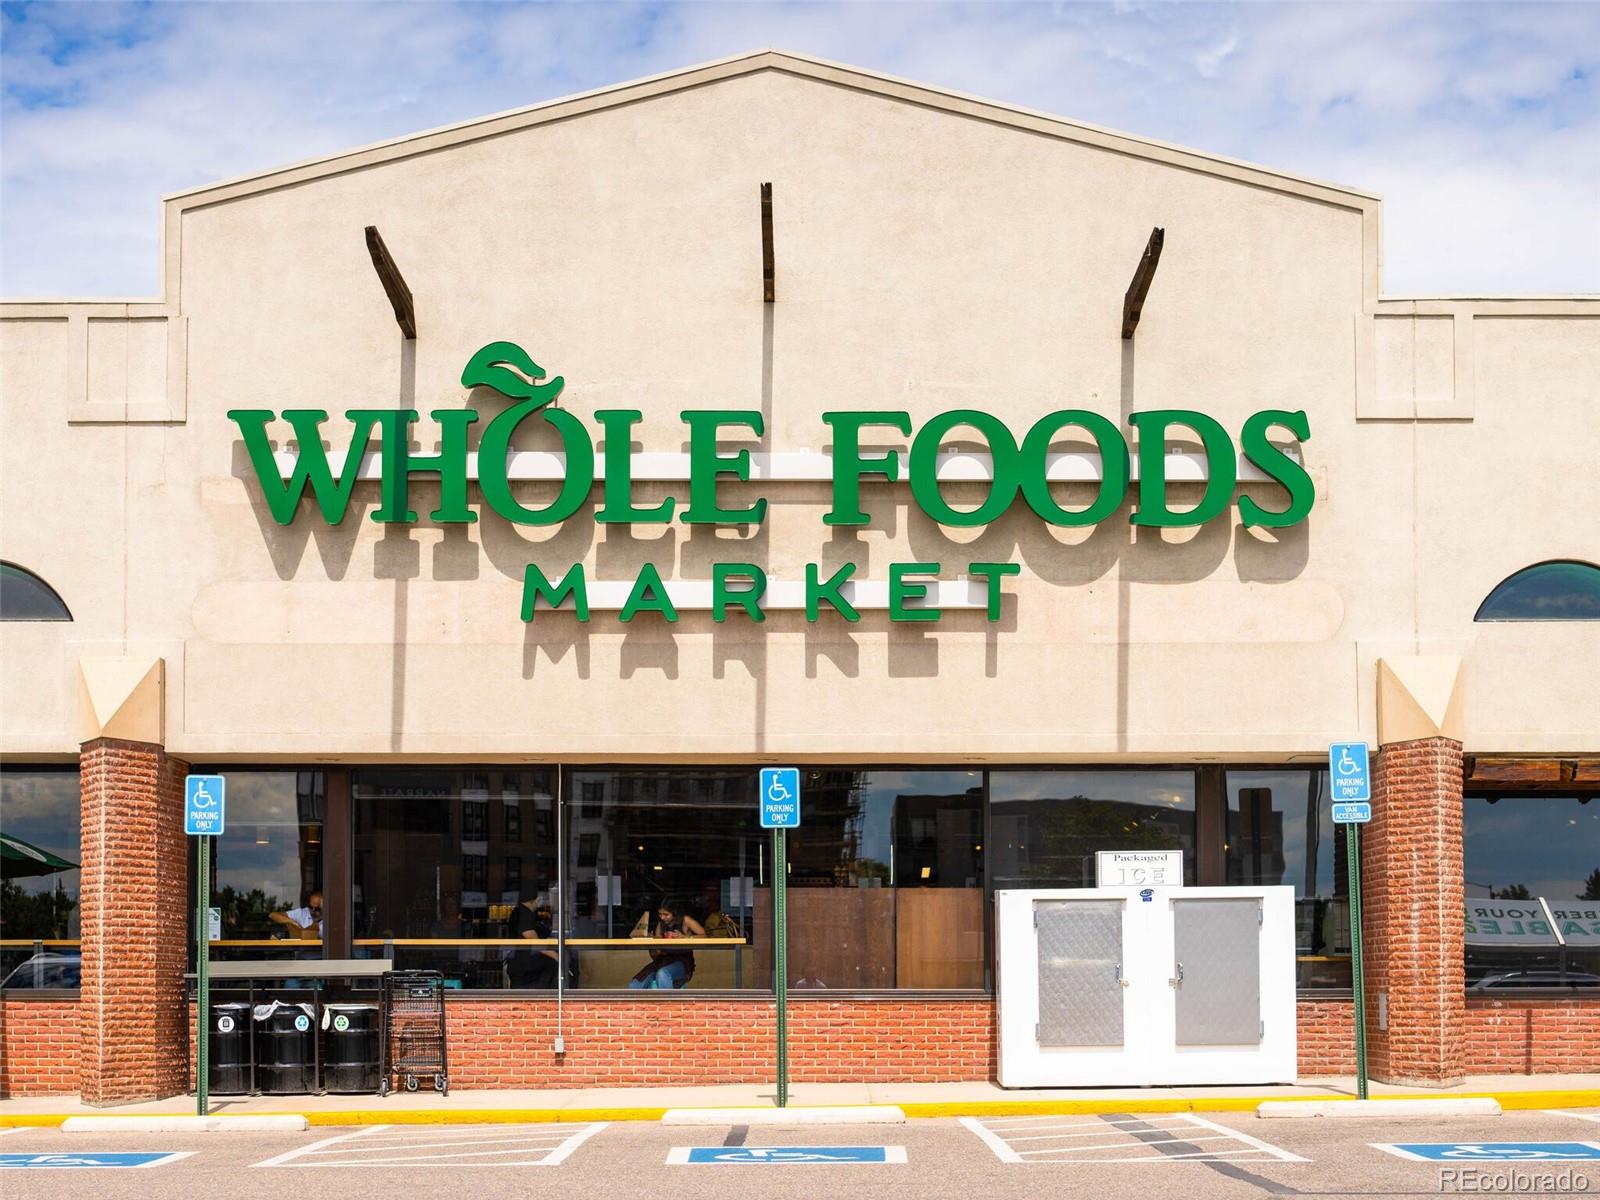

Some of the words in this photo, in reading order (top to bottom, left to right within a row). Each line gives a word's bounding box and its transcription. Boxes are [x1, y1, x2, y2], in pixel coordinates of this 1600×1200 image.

[227, 405, 767, 526] WHOLE
[822, 410, 1315, 528] FOODS
[521, 562, 1020, 623] MARKET
[1336, 778, 1365, 787] PARKING
[1342, 787, 1359, 795] ONLY
[766, 804, 794, 813] PARKING
[190, 811, 219, 821] PARKING
[771, 813, 788, 822] ONLY
[1336, 812, 1368, 820] ACCESSIBLE
[195, 820, 213, 829] ONLY
[1114, 854, 1168, 863] Packaged
[1117, 867, 1165, 885] ICE
